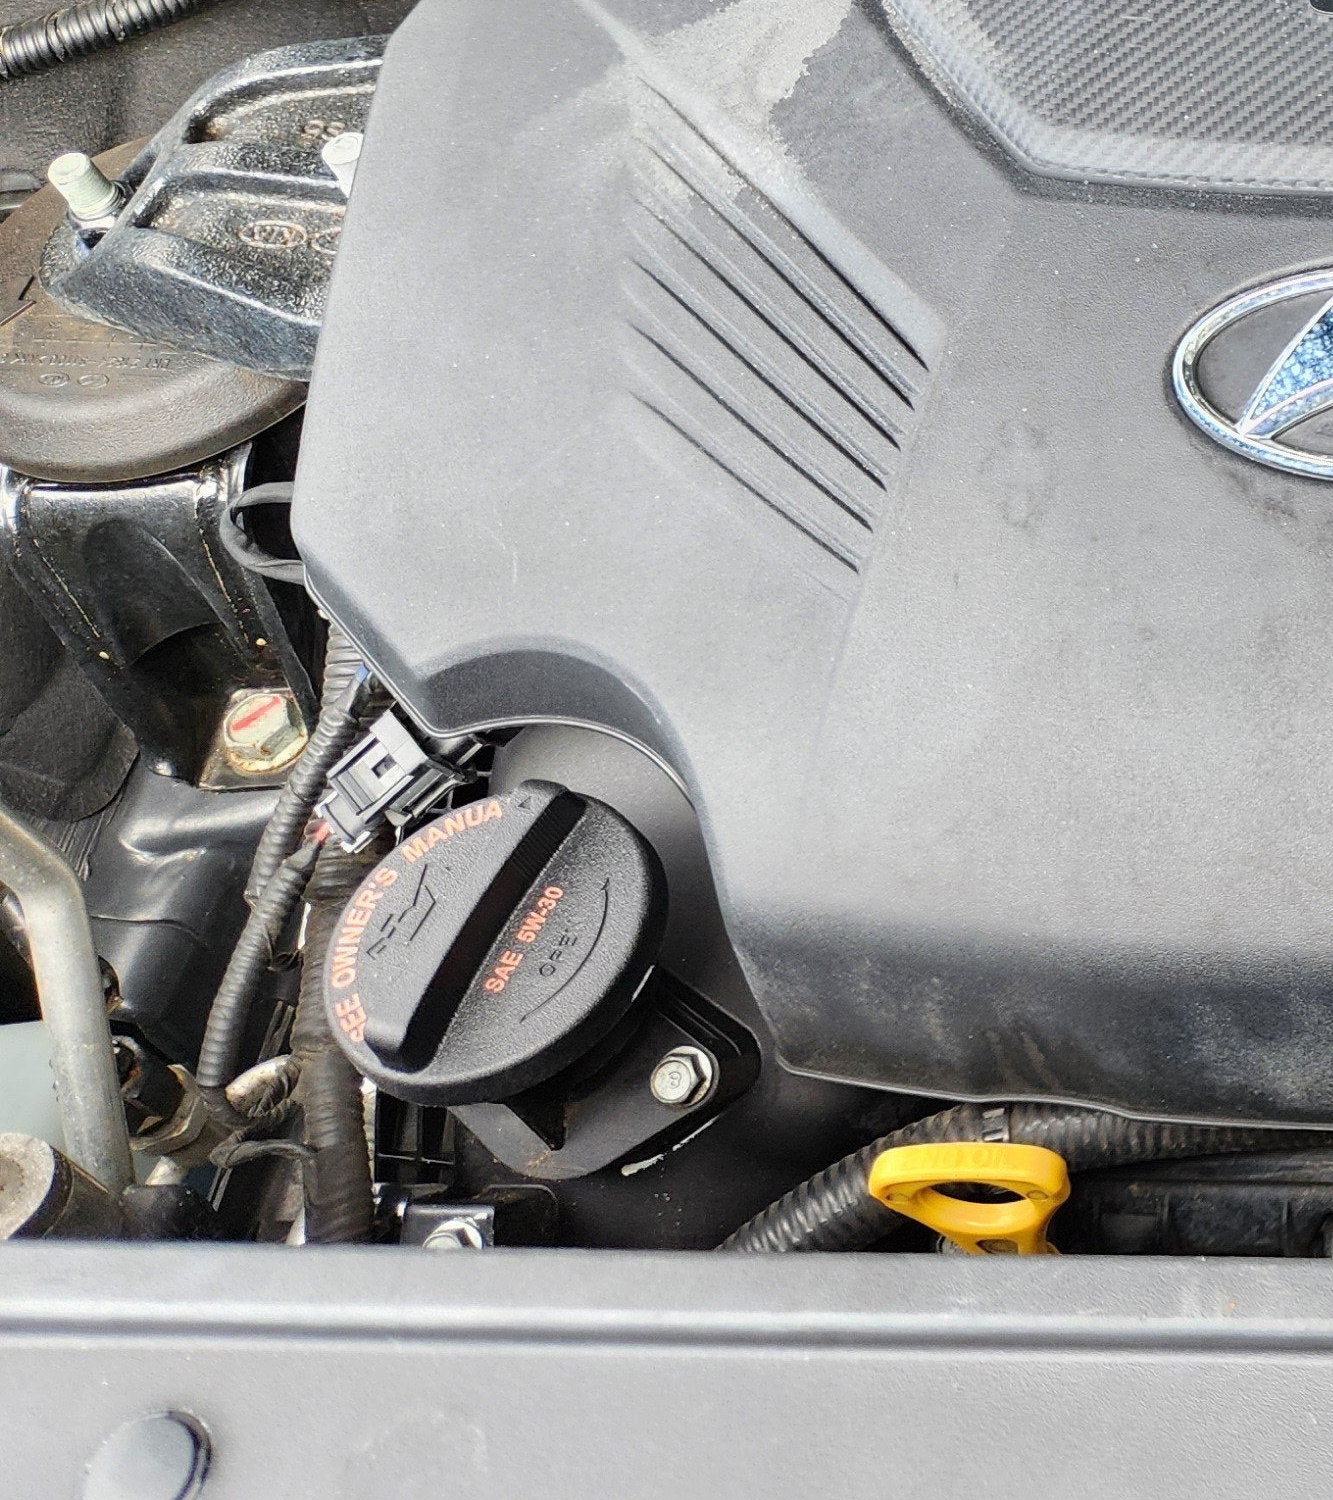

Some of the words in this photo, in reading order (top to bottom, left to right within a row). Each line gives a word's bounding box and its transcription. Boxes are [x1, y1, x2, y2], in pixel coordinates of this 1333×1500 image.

[331, 866, 399, 990] OWNER'S
[401, 796, 511, 865] MANUA
[483, 949, 525, 995] SAE
[515, 884, 565, 945] 5W-30
